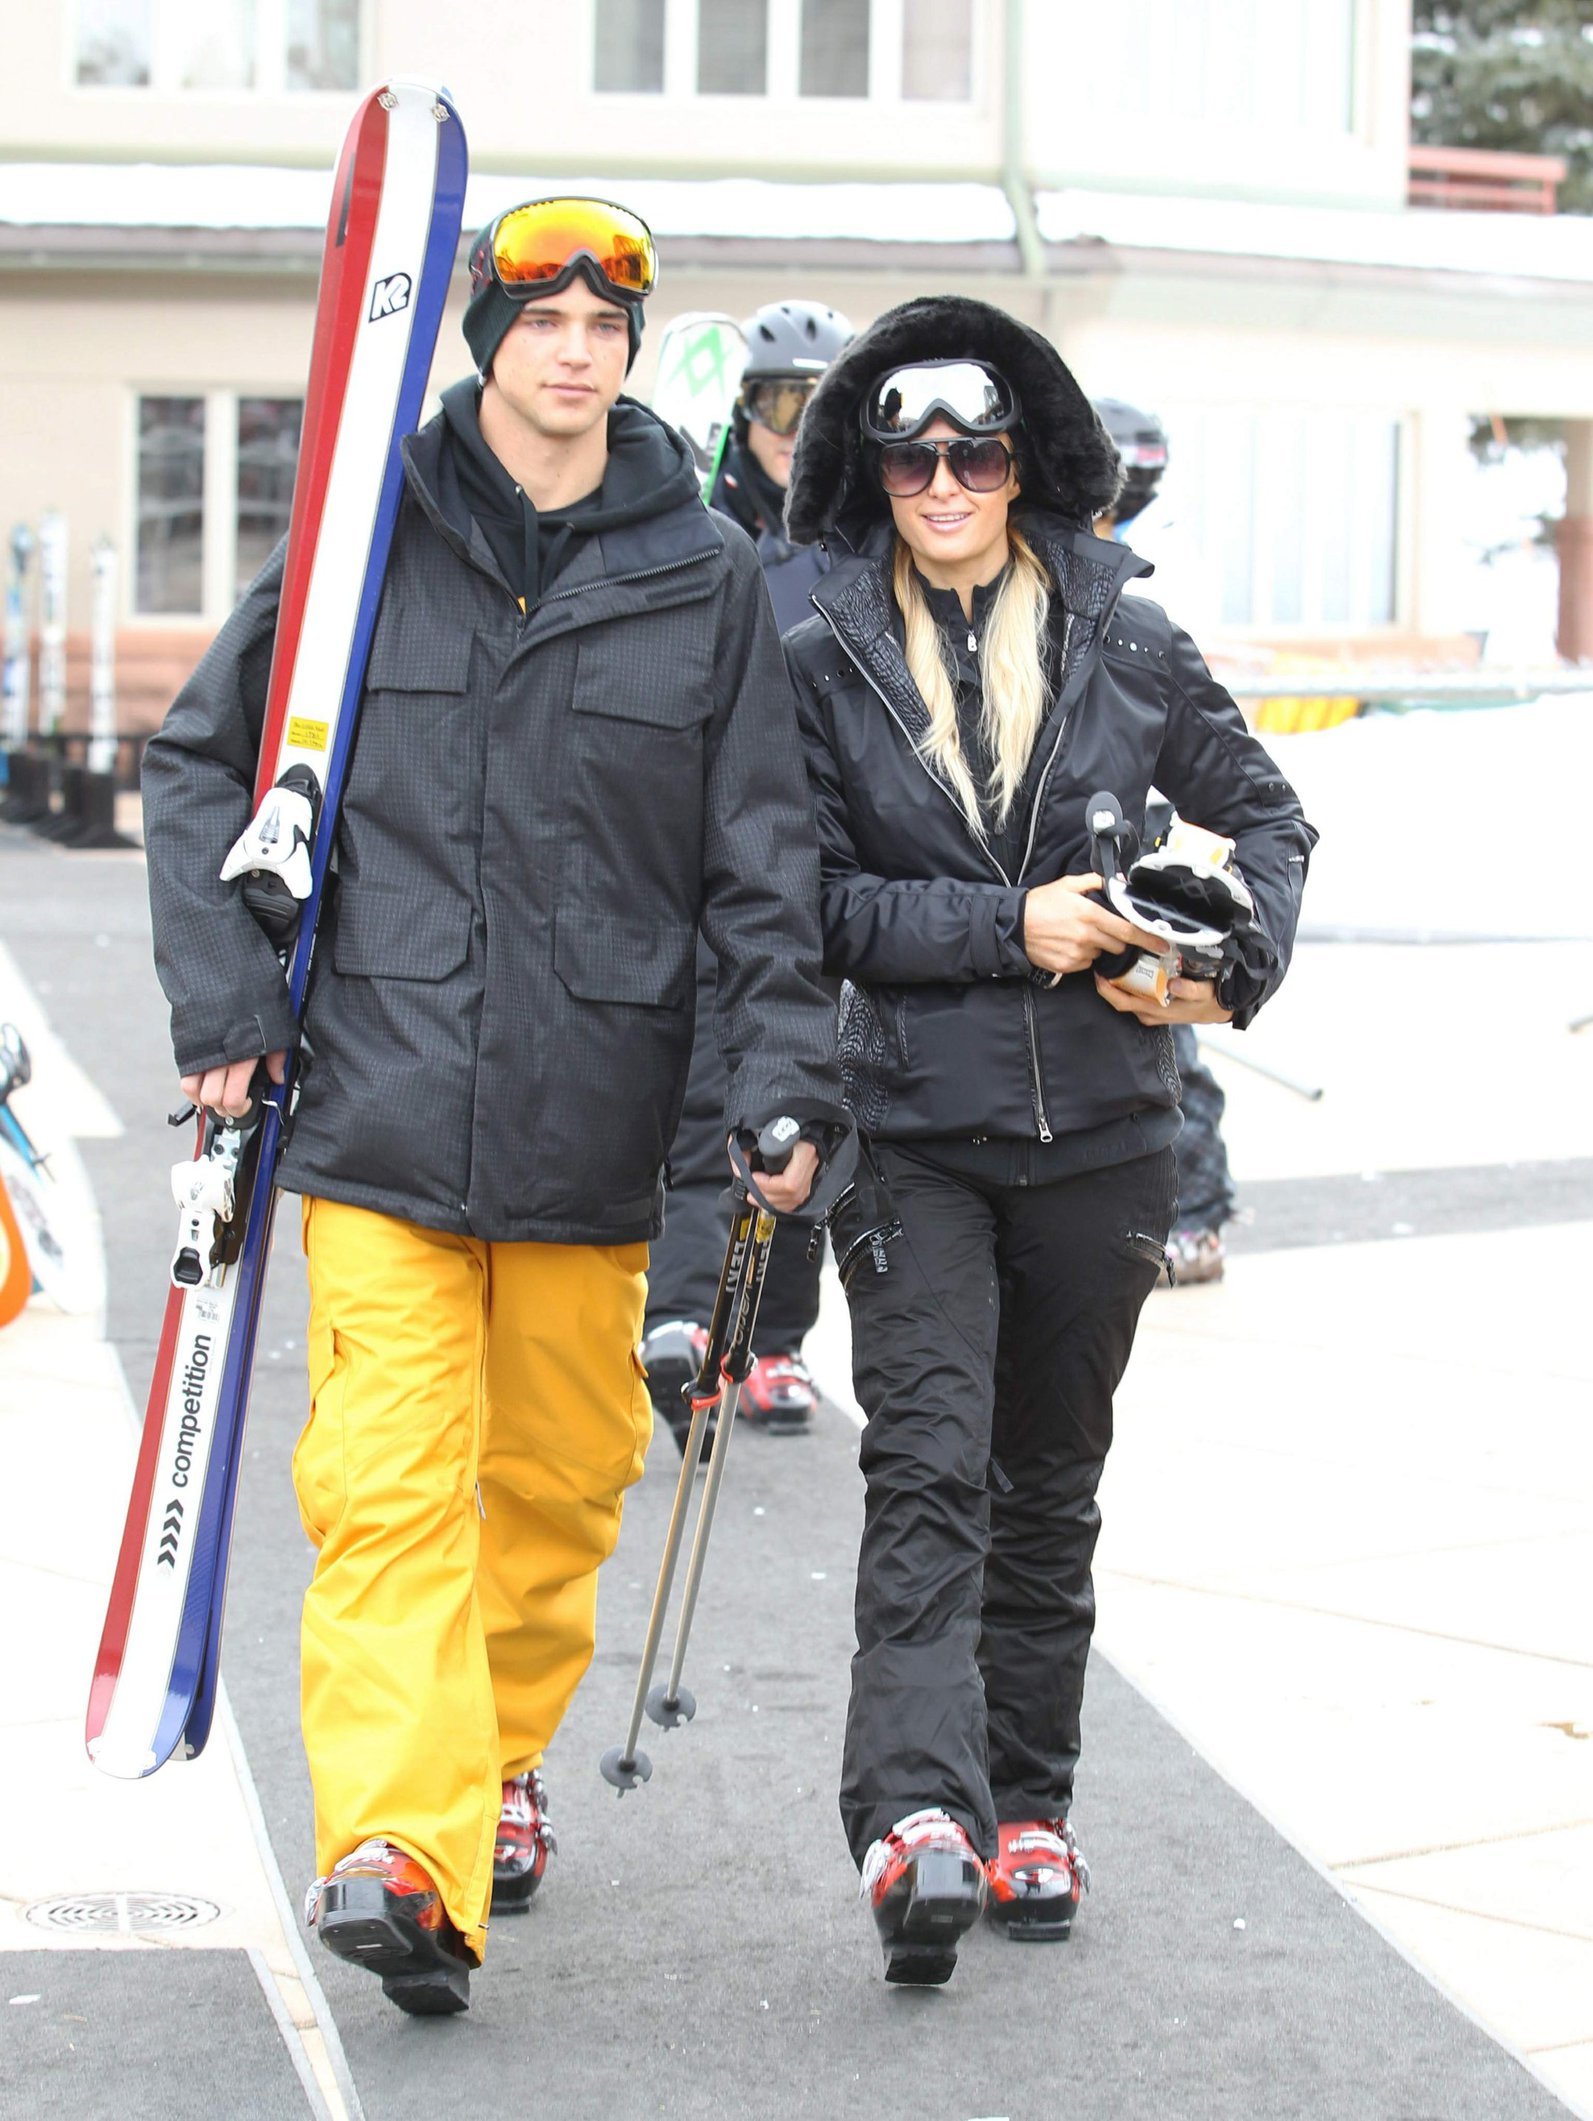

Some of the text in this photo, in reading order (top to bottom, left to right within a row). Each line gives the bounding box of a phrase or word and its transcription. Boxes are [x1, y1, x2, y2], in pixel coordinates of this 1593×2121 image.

[369, 272, 412, 322] K2
[725, 1240, 746, 1293] LEKI
[172, 1334, 212, 1488] competition
